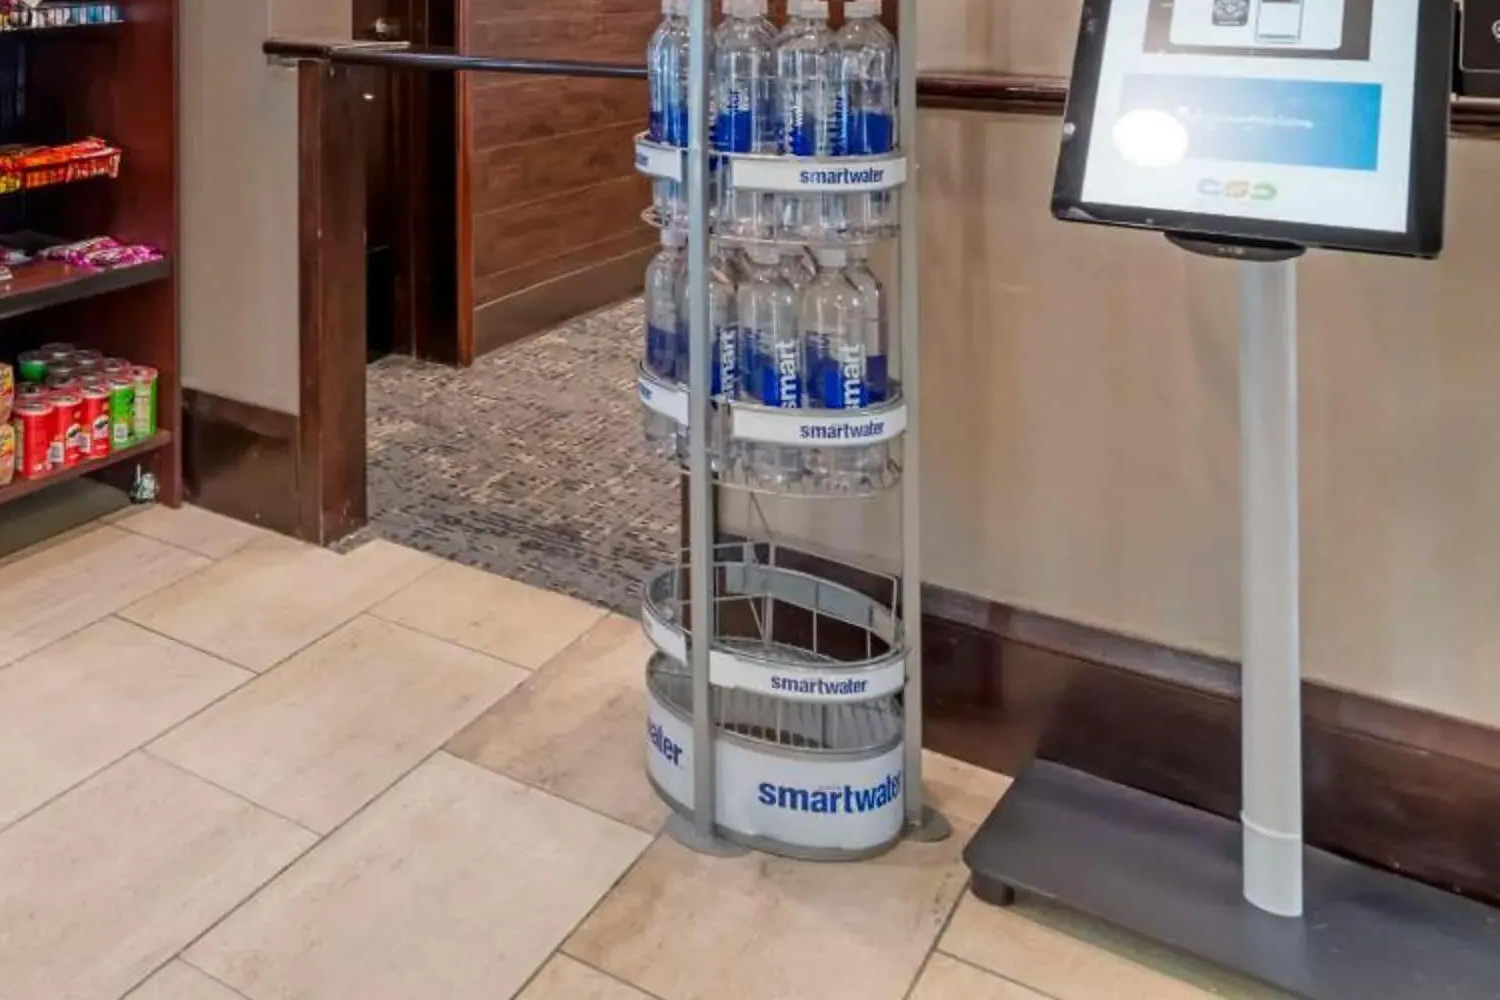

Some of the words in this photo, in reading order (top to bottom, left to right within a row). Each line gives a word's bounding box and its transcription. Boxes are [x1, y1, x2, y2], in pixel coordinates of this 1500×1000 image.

[799, 167, 884, 184] smartwater
[776, 339, 796, 408] smart
[799, 421, 884, 439] smartwater
[771, 674, 868, 695] smartwater
[757, 770, 901, 814] smartwater
